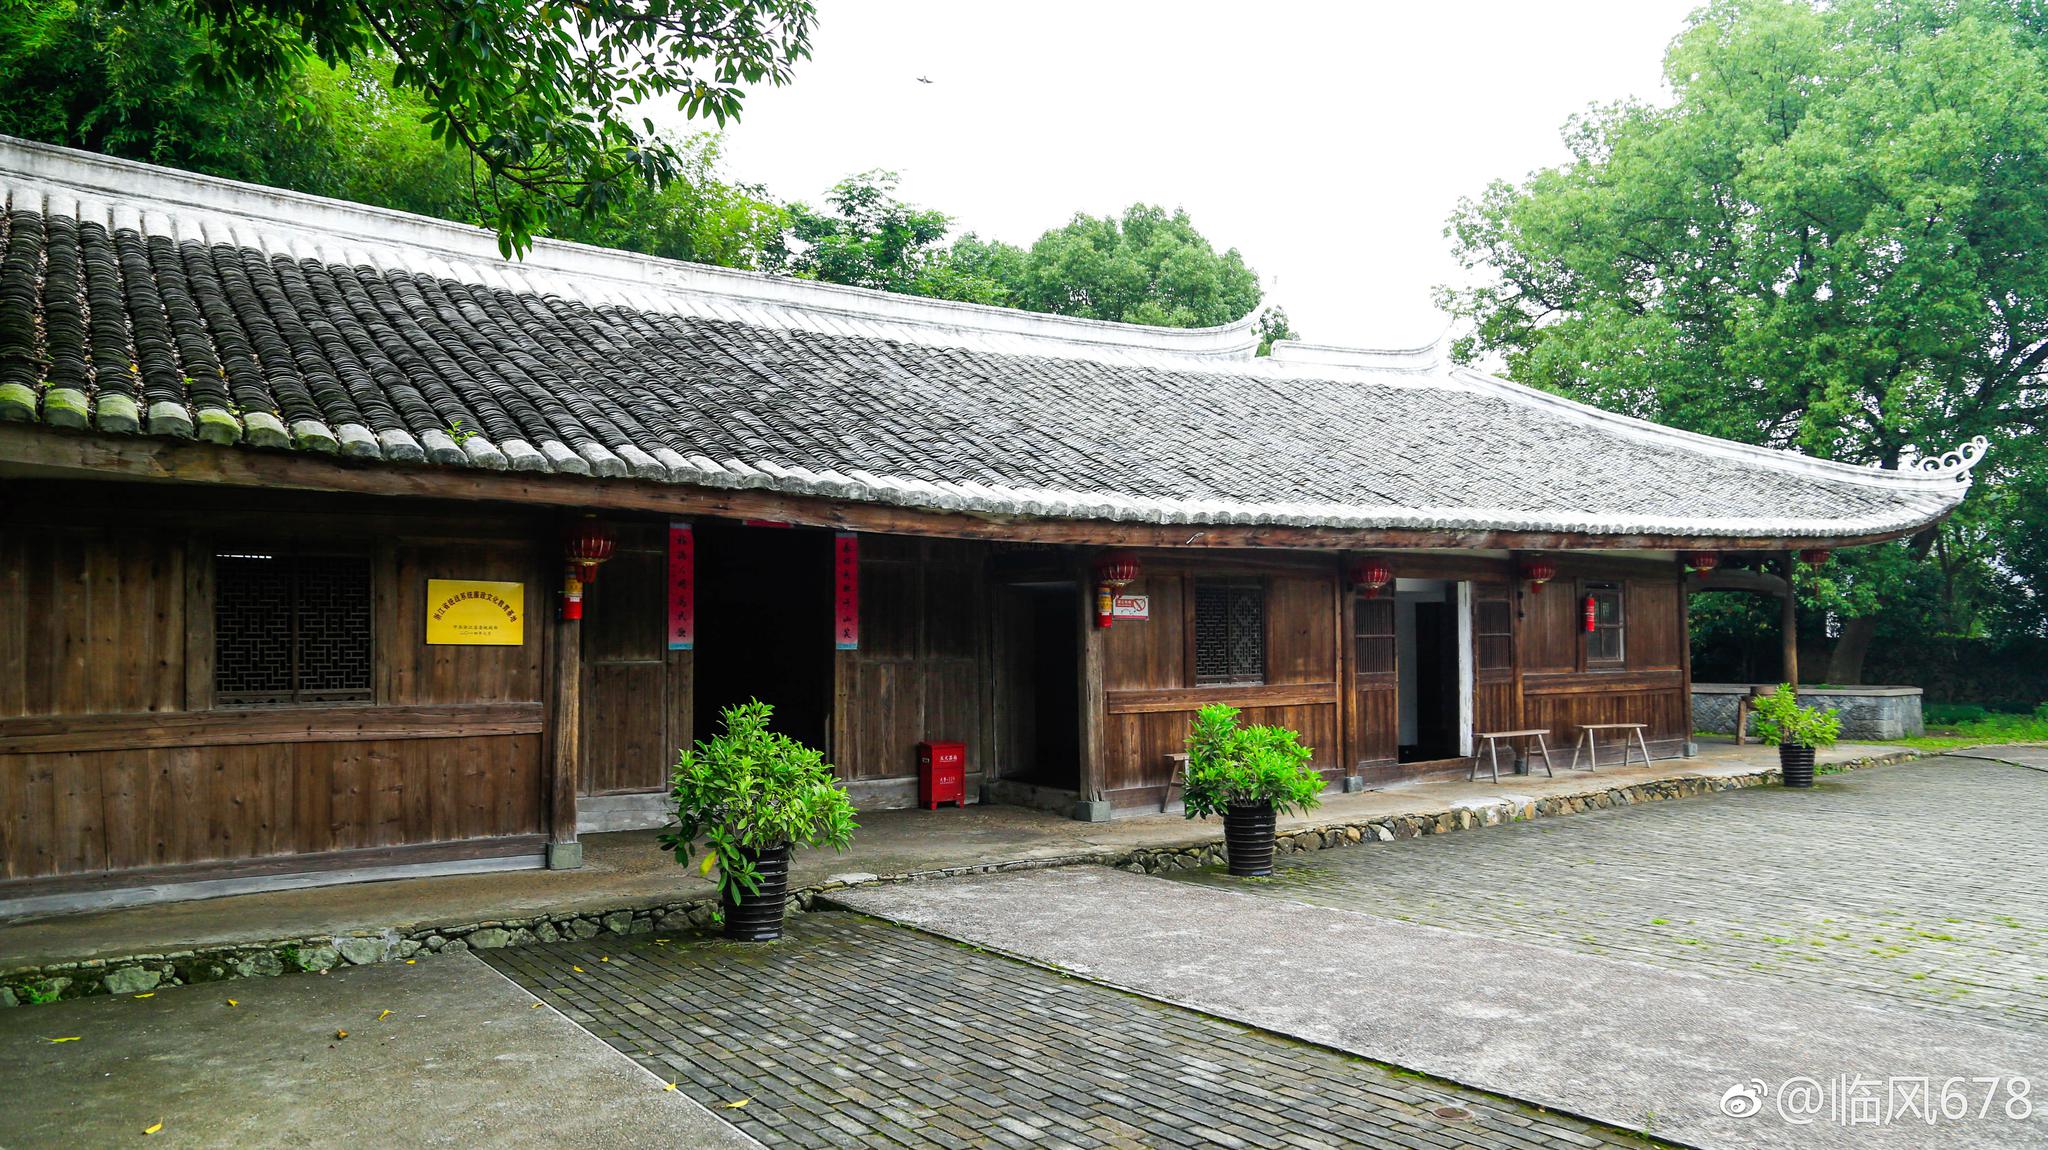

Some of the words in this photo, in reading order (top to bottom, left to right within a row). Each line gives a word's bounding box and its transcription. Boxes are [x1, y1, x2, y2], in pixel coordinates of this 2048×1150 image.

[433, 590, 518, 623] 浙江省统战系统廉政文化教育基地
